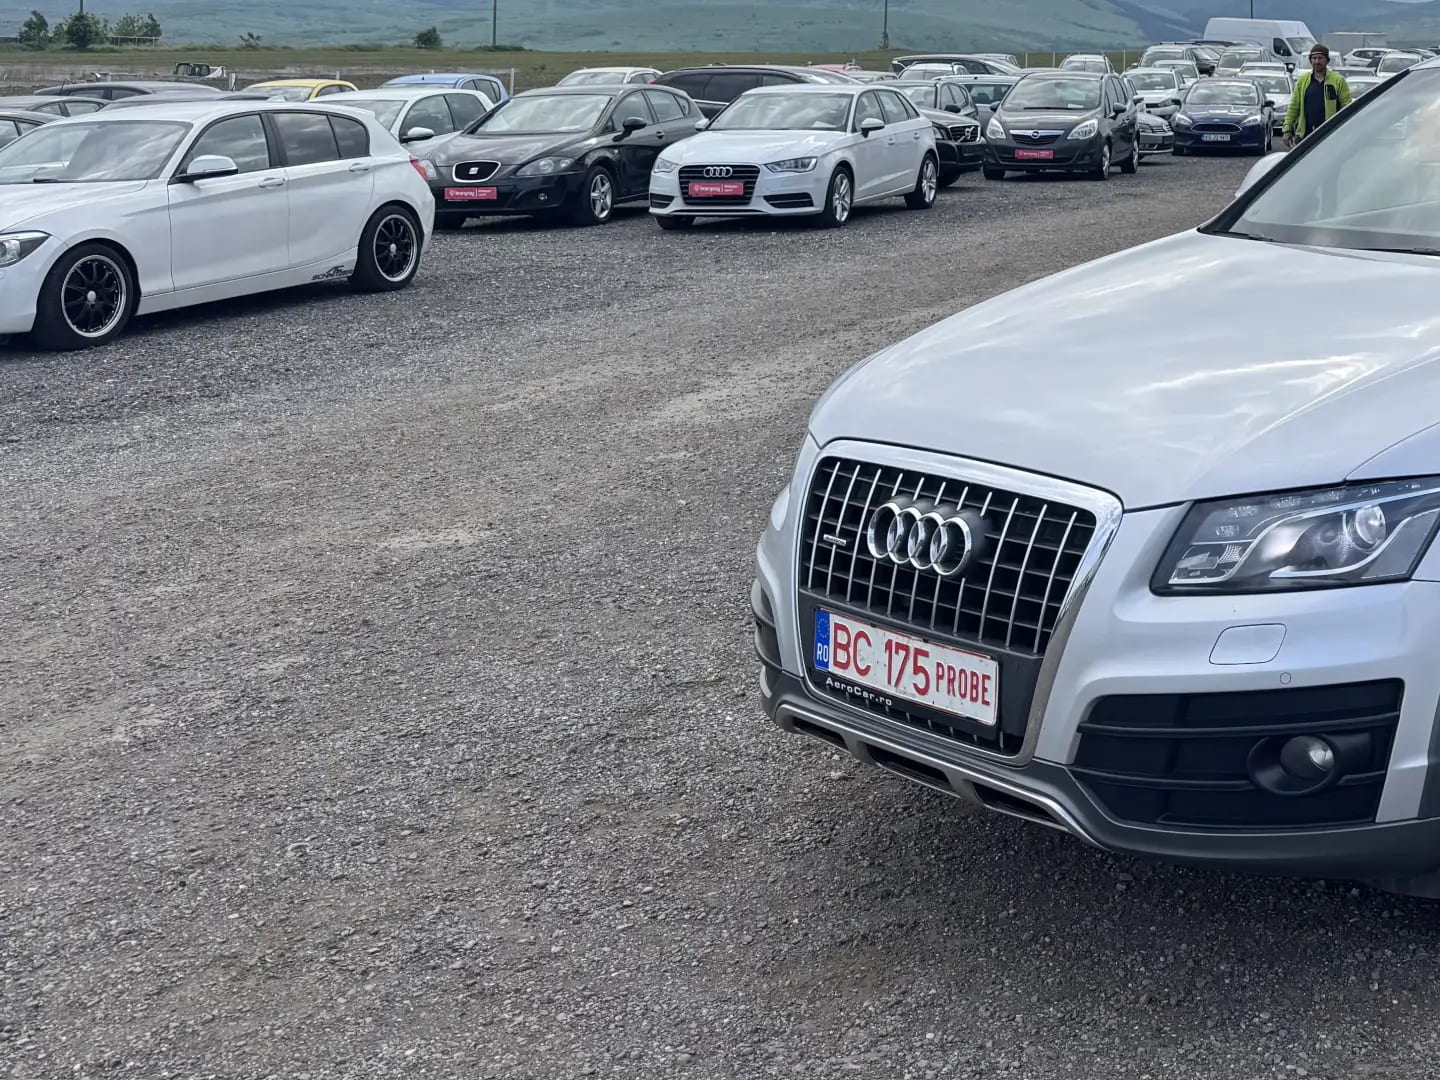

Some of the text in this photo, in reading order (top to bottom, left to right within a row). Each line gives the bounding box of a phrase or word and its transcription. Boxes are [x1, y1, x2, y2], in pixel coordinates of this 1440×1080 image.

[816, 642, 829, 664] RO
[832, 622, 992, 706] BC 175 PROBE
[825, 676, 893, 706] AeroCar.ro
